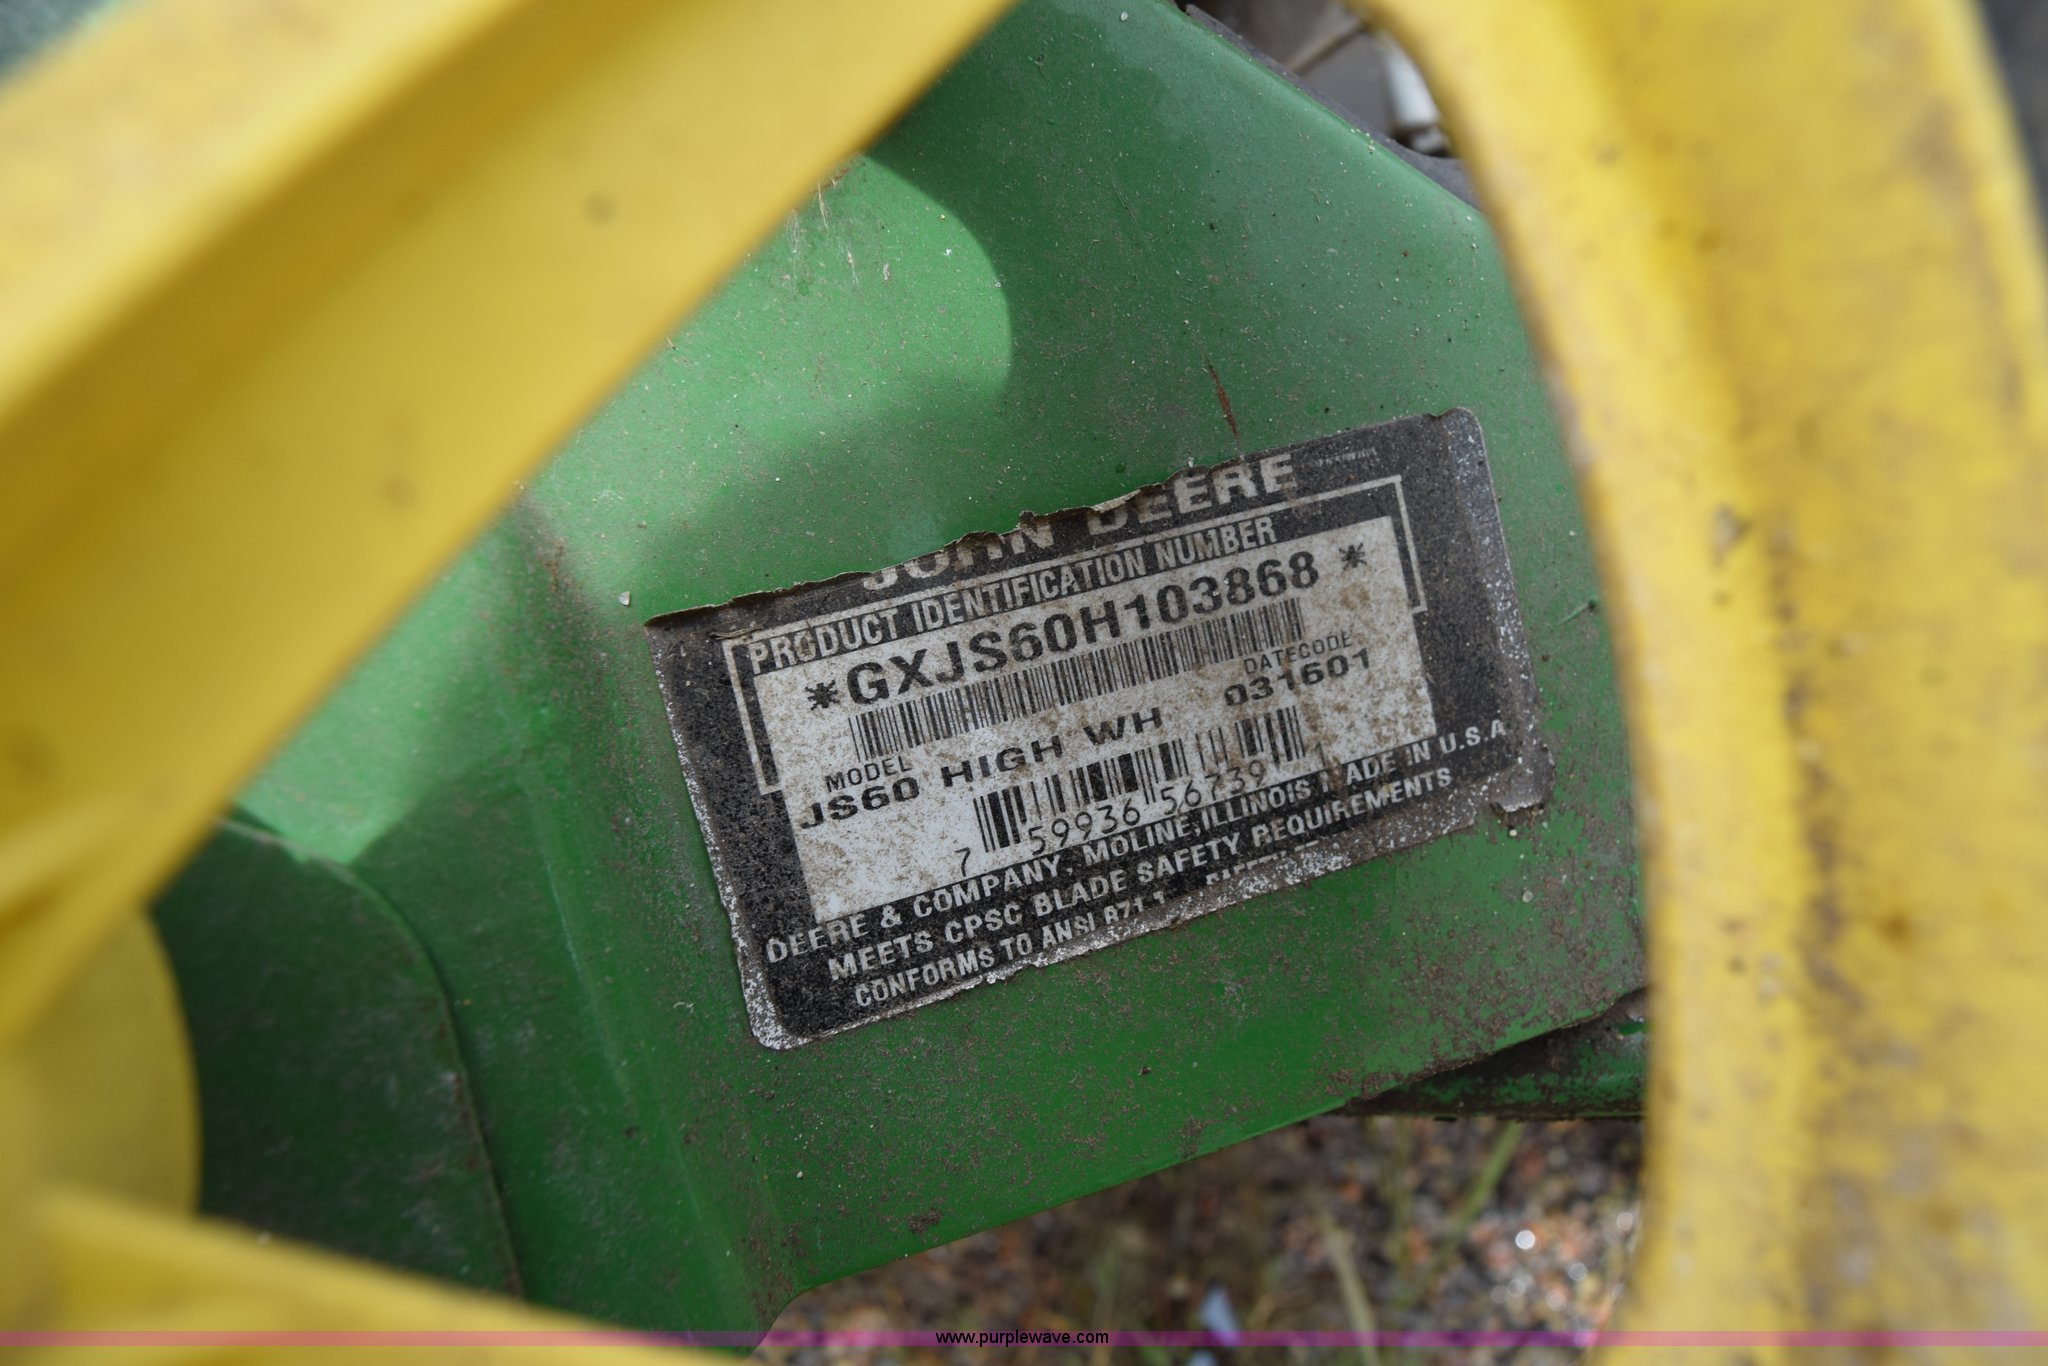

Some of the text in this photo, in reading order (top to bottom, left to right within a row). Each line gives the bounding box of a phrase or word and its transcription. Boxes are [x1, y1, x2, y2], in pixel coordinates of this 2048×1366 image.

[1086, 453, 1298, 535] DEERE
[751, 516, 1277, 675] PRODUCT IDENTIFICATION NUMBER
[1223, 648, 1371, 708] 031601
[1243, 631, 1351, 675] DATECODE
[801, 706, 1162, 829] JS60 HIGH WH
[825, 756, 913, 792] MODEL
[955, 847, 973, 877] 7
[1028, 798, 1141, 856] 59936
[1159, 760, 1267, 815] 56739
[766, 914, 869, 964] DEERE
[879, 903, 902, 929] &
[913, 855, 1074, 918] COMPANY,
[1403, 740, 1432, 766] IN
[828, 929, 934, 981] MEETS
[945, 902, 1022, 944] CPSC
[1035, 868, 1127, 917] BLADE
[1137, 831, 1240, 885] SAFETY
[1252, 766, 1453, 849] REQUIREMENTS
[854, 946, 995, 1008] CONFORMS
[1001, 936, 1034, 962] TO
[1041, 912, 1096, 949] ANSI
